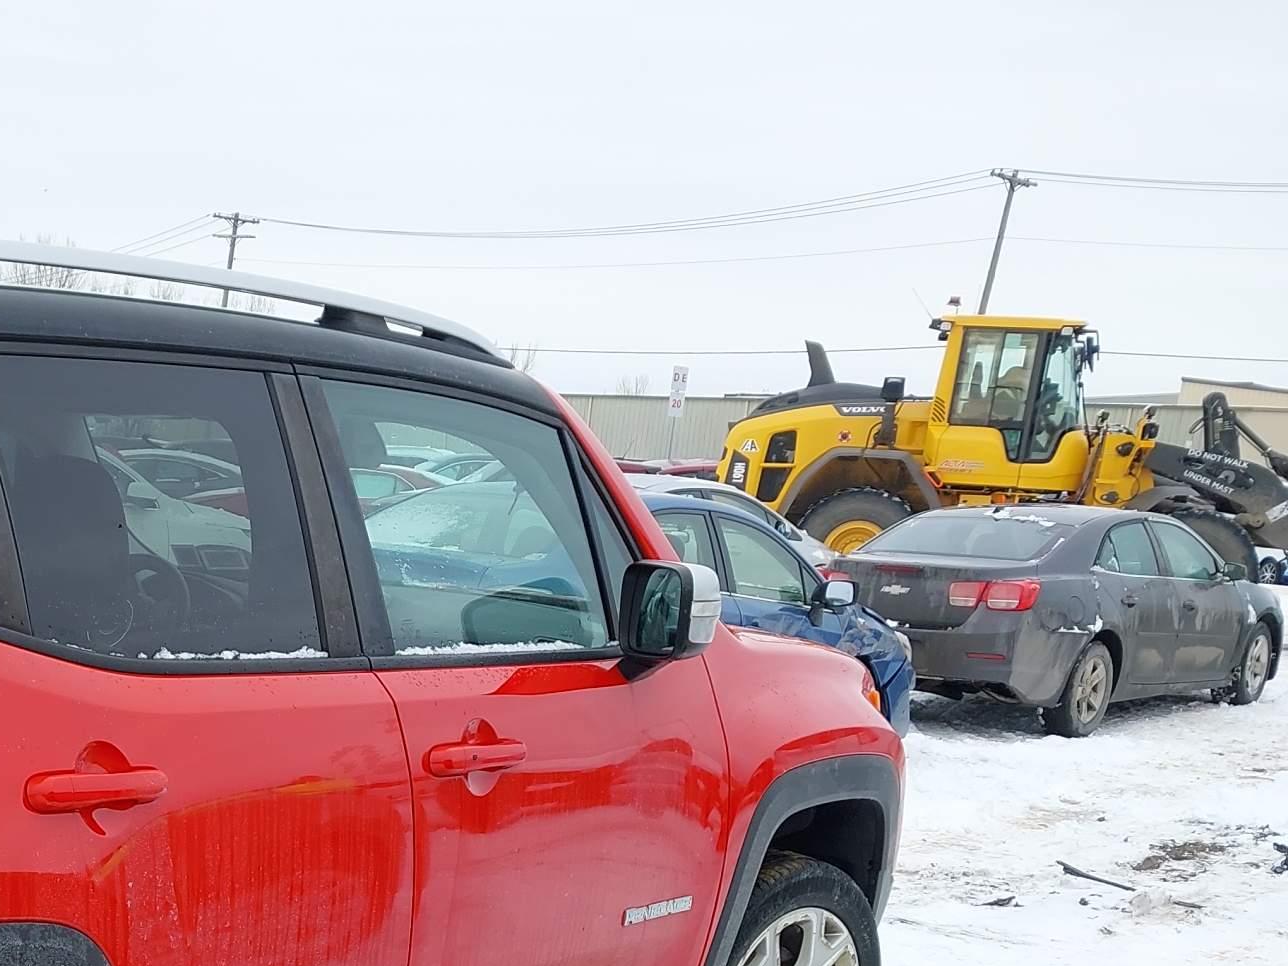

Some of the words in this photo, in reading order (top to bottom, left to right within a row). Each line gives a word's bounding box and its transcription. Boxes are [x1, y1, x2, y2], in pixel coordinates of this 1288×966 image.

[671, 398, 682, 409] 20
[1187, 448, 1202, 457] DO
[1202, 451, 1223, 463] NOT
[1223, 456, 1249, 469] WALK
[1183, 469, 1212, 486] UNDER
[1212, 480, 1235, 495] MAST
